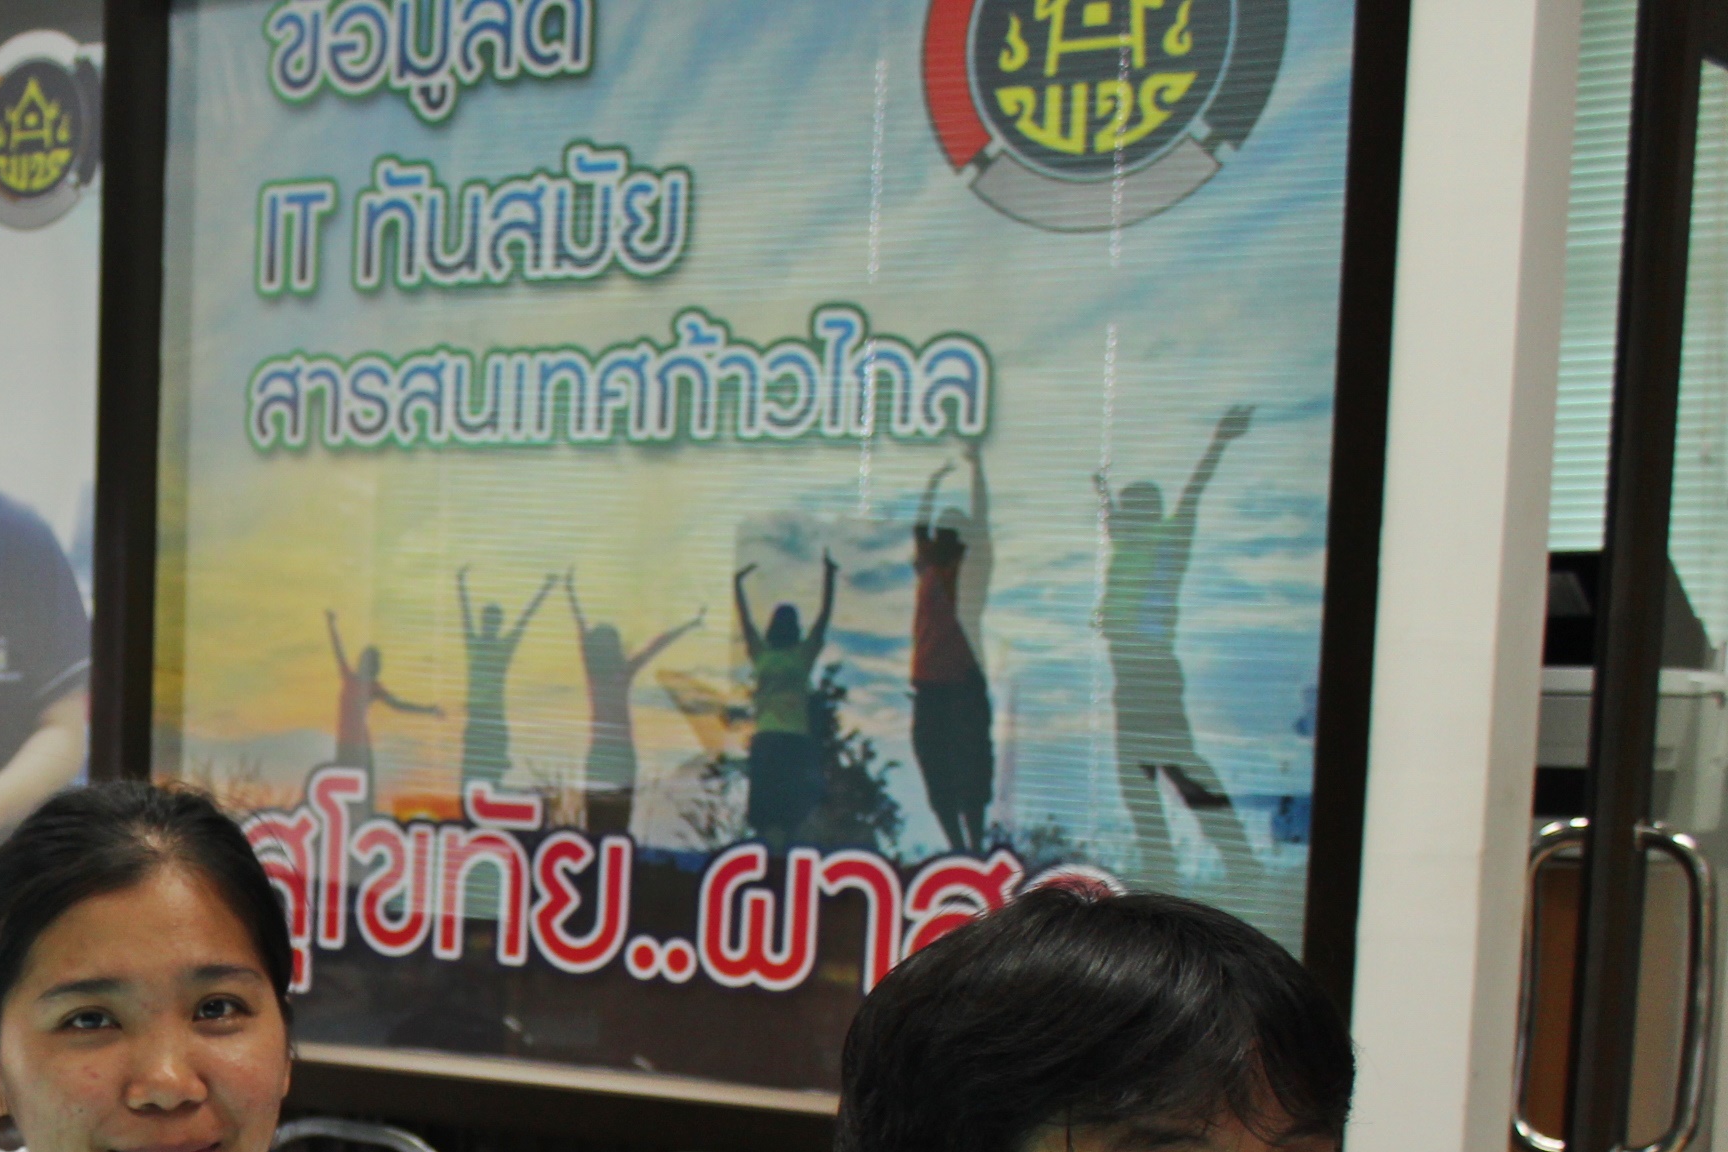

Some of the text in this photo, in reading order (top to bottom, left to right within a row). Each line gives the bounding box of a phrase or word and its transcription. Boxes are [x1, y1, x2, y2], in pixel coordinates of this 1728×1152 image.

[268, 0, 590, 120] ขอมูลด
[259, 145, 692, 292] IT ทันสมัย
[250, 307, 990, 445] สารสนเทศก้าวไกล
